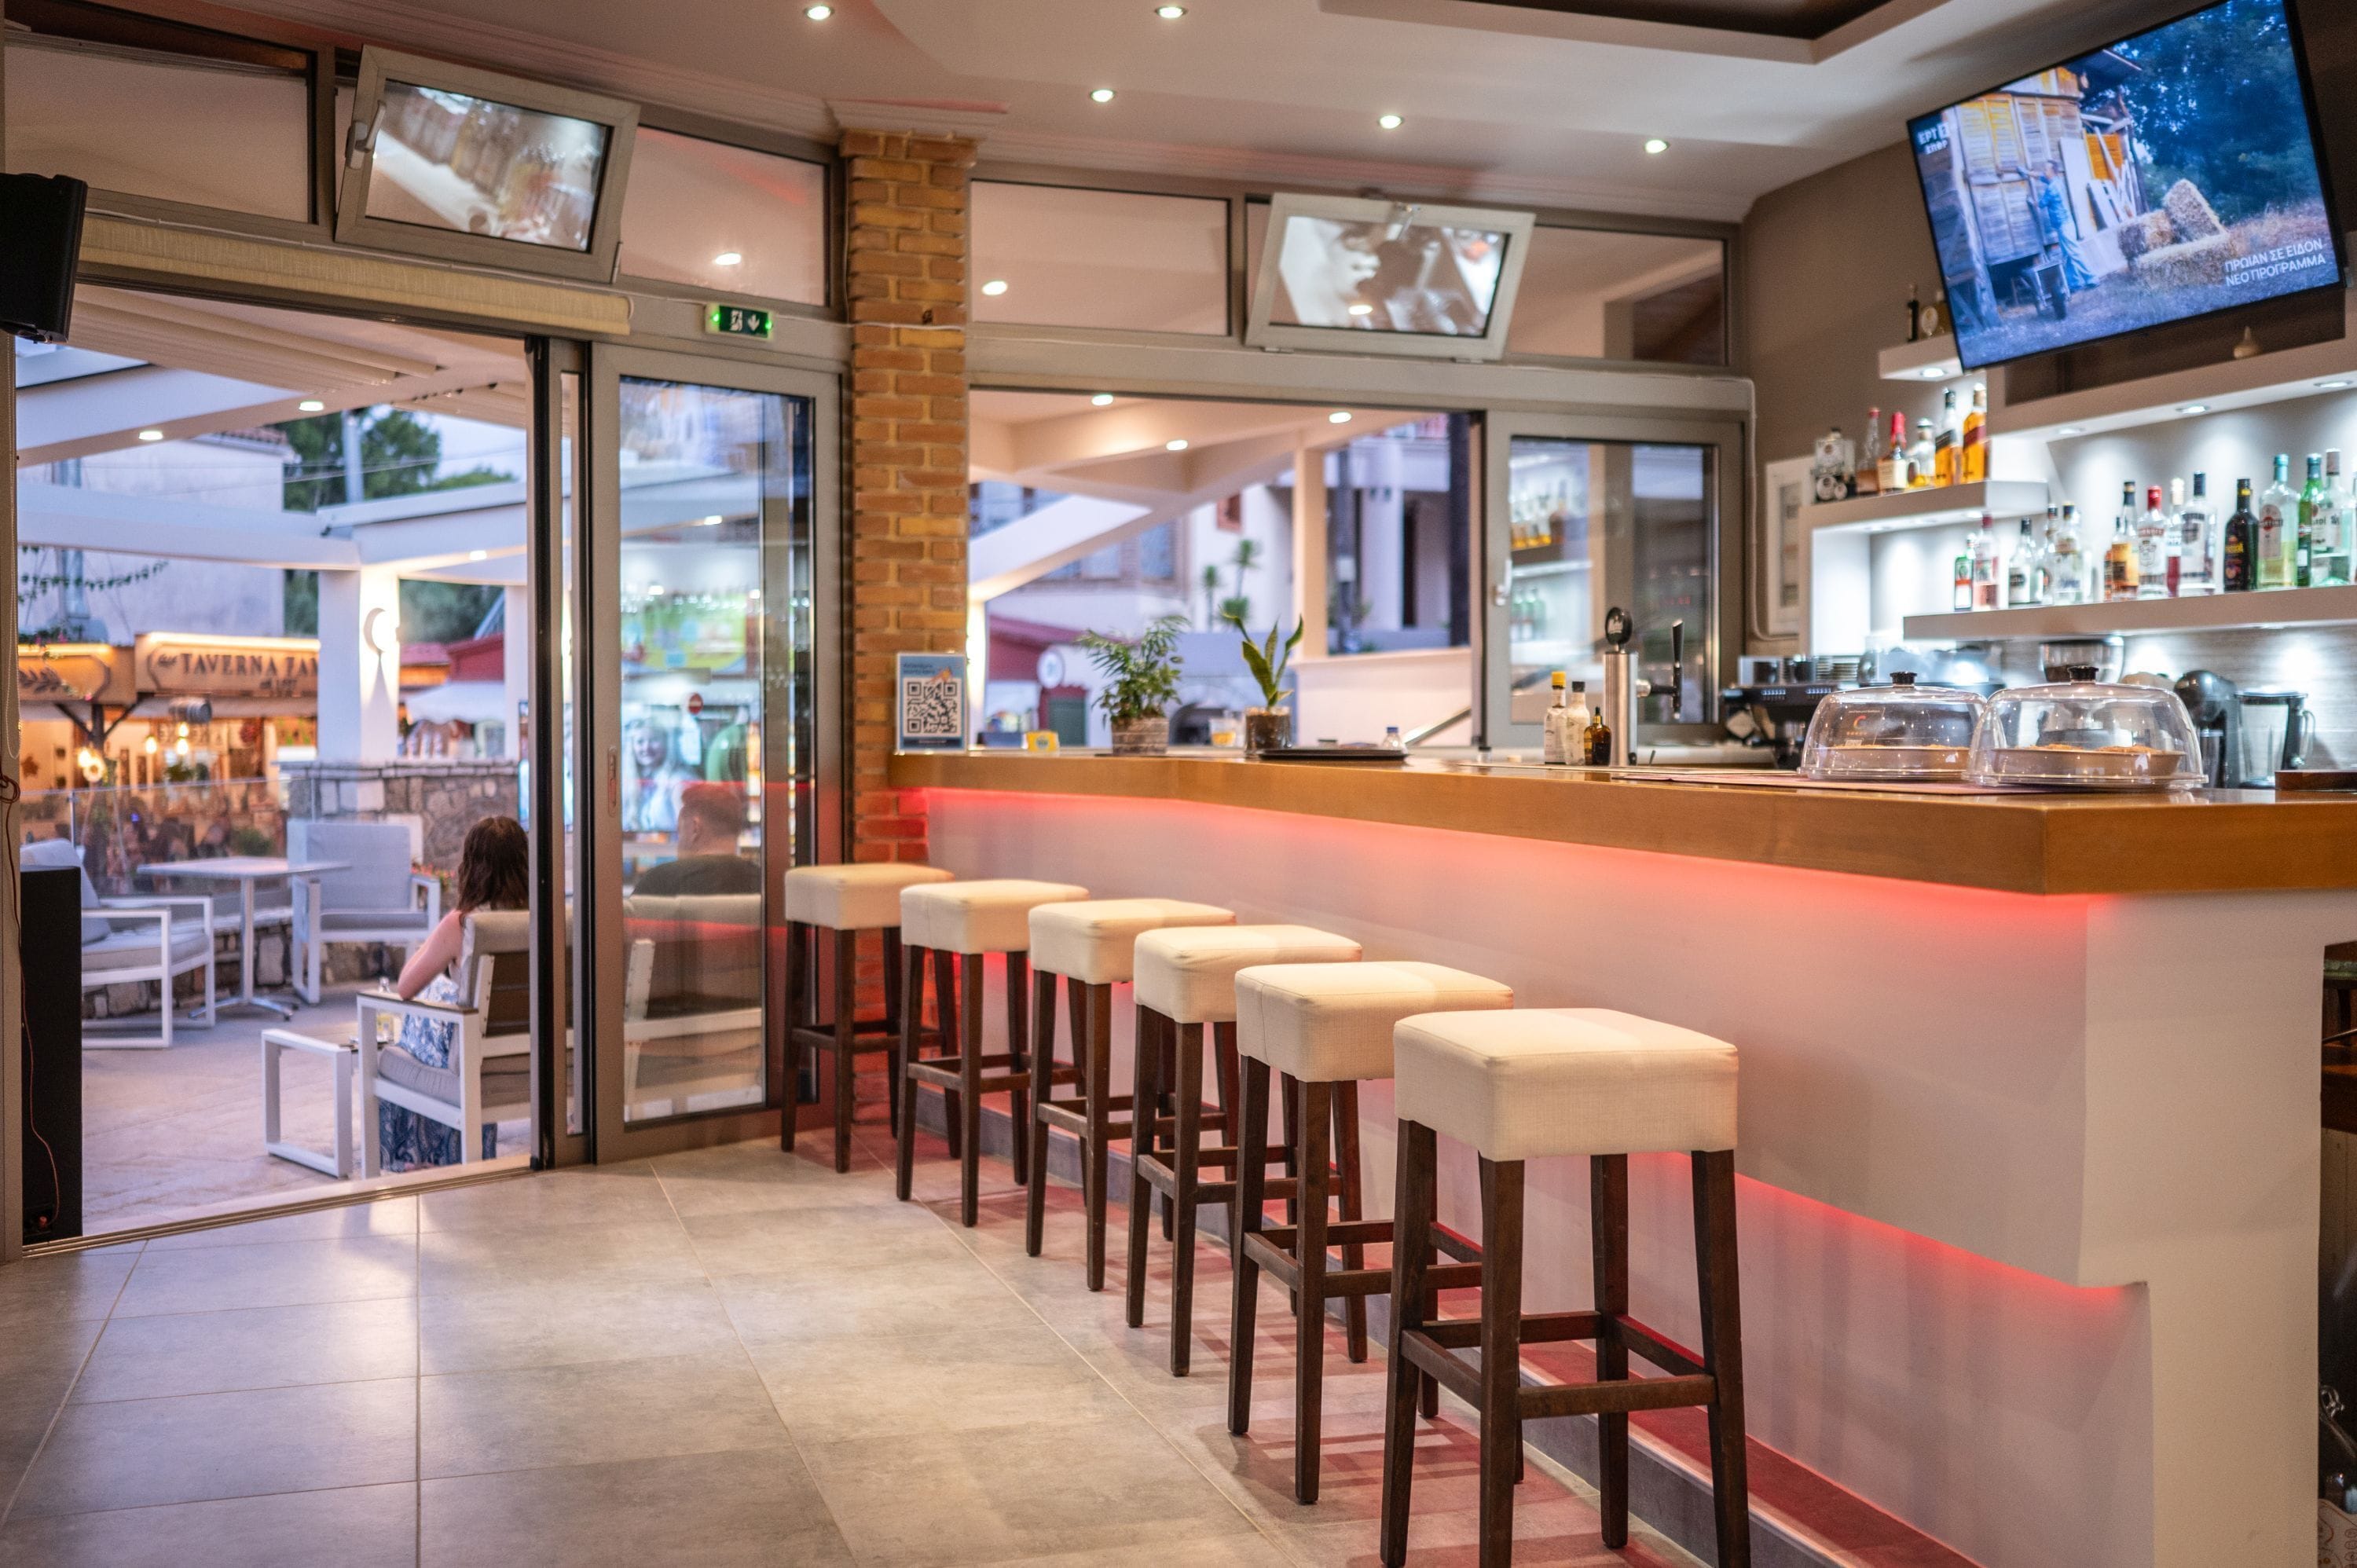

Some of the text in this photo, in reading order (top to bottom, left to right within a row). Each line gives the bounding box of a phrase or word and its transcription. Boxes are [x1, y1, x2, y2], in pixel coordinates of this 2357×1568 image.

[2224, 238, 2323, 273] ΠΡΩΙΑΝ ΣΕ ΕΙΔΟΝ
[2225, 253, 2326, 287] ΝΕΟ ΠΡΟΓΡΑΜΜΑ
[180, 653, 278, 676] TAVERNA
